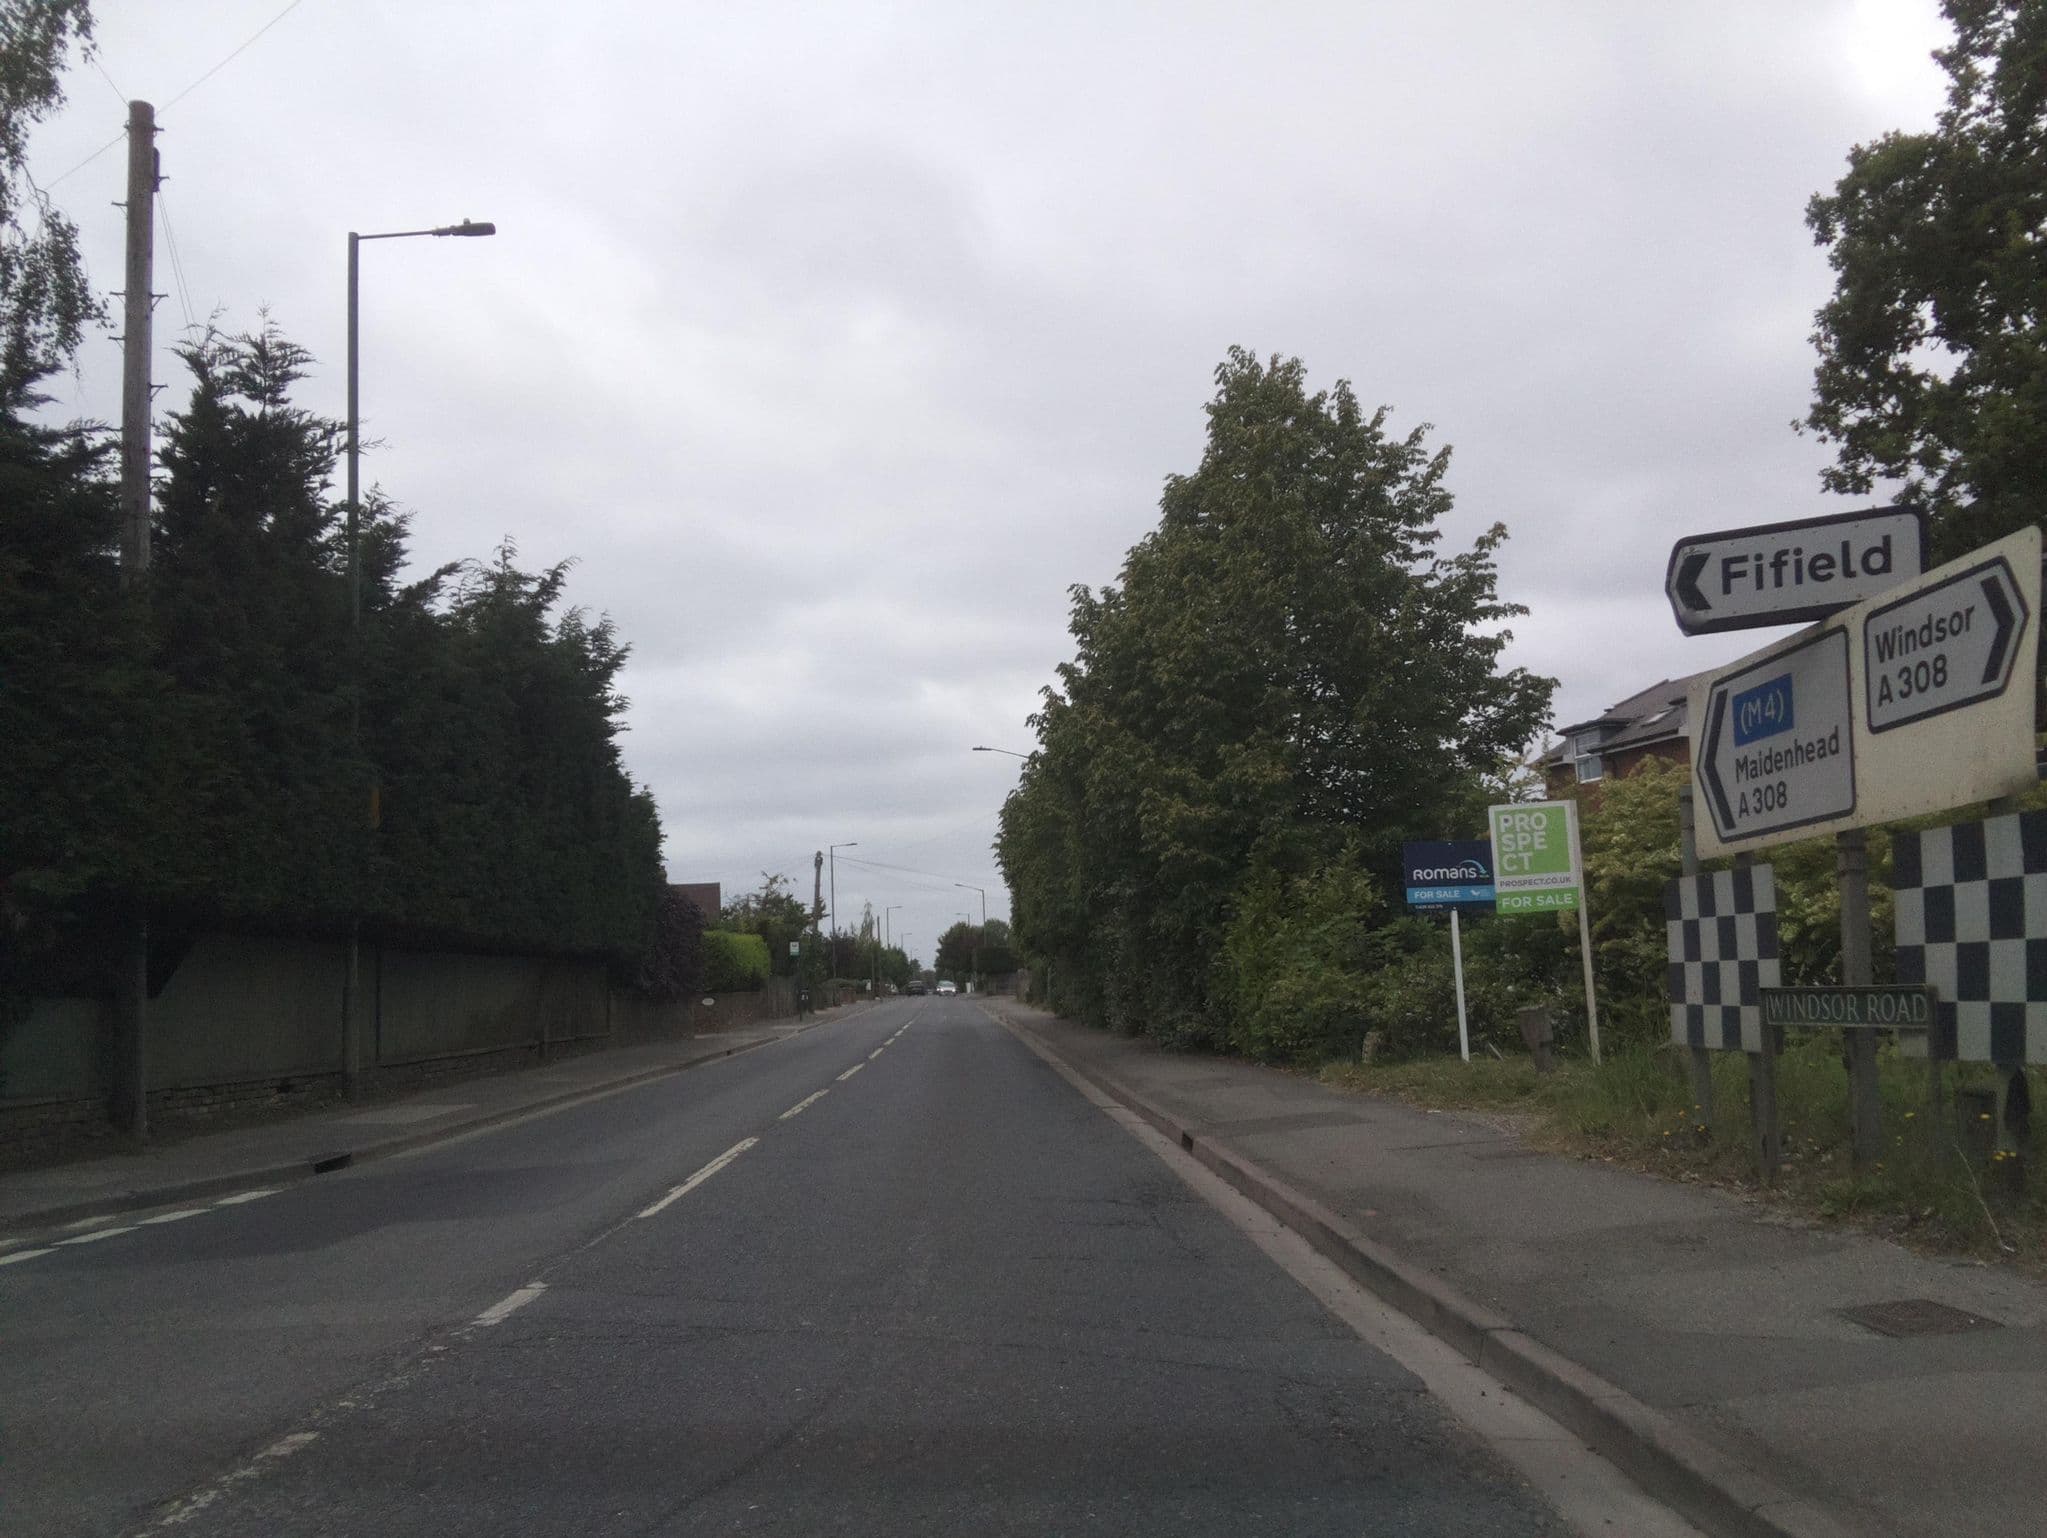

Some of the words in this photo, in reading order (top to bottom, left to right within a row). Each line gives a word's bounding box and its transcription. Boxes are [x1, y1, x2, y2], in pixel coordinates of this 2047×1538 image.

[1721, 535, 1892, 595] Fifield
[1874, 605, 1976, 664] Windsor
[1740, 688, 1785, 736] (M4)
[1735, 726, 1840, 785] Maidenhead
[1500, 812, 1547, 833] PRO
[1501, 831, 1548, 851] SPE
[1503, 852, 1533, 872] CT
[1500, 876, 1572, 888] PROSPECT.CO.UK
[1414, 891, 1433, 899] FOR
[1436, 889, 1461, 898] SALE
[1503, 897, 1532, 908] FOR
[1537, 893, 1573, 905] SALE
[1769, 993, 1860, 1021] WINDSOR
[1867, 993, 1928, 1022] ROAD
